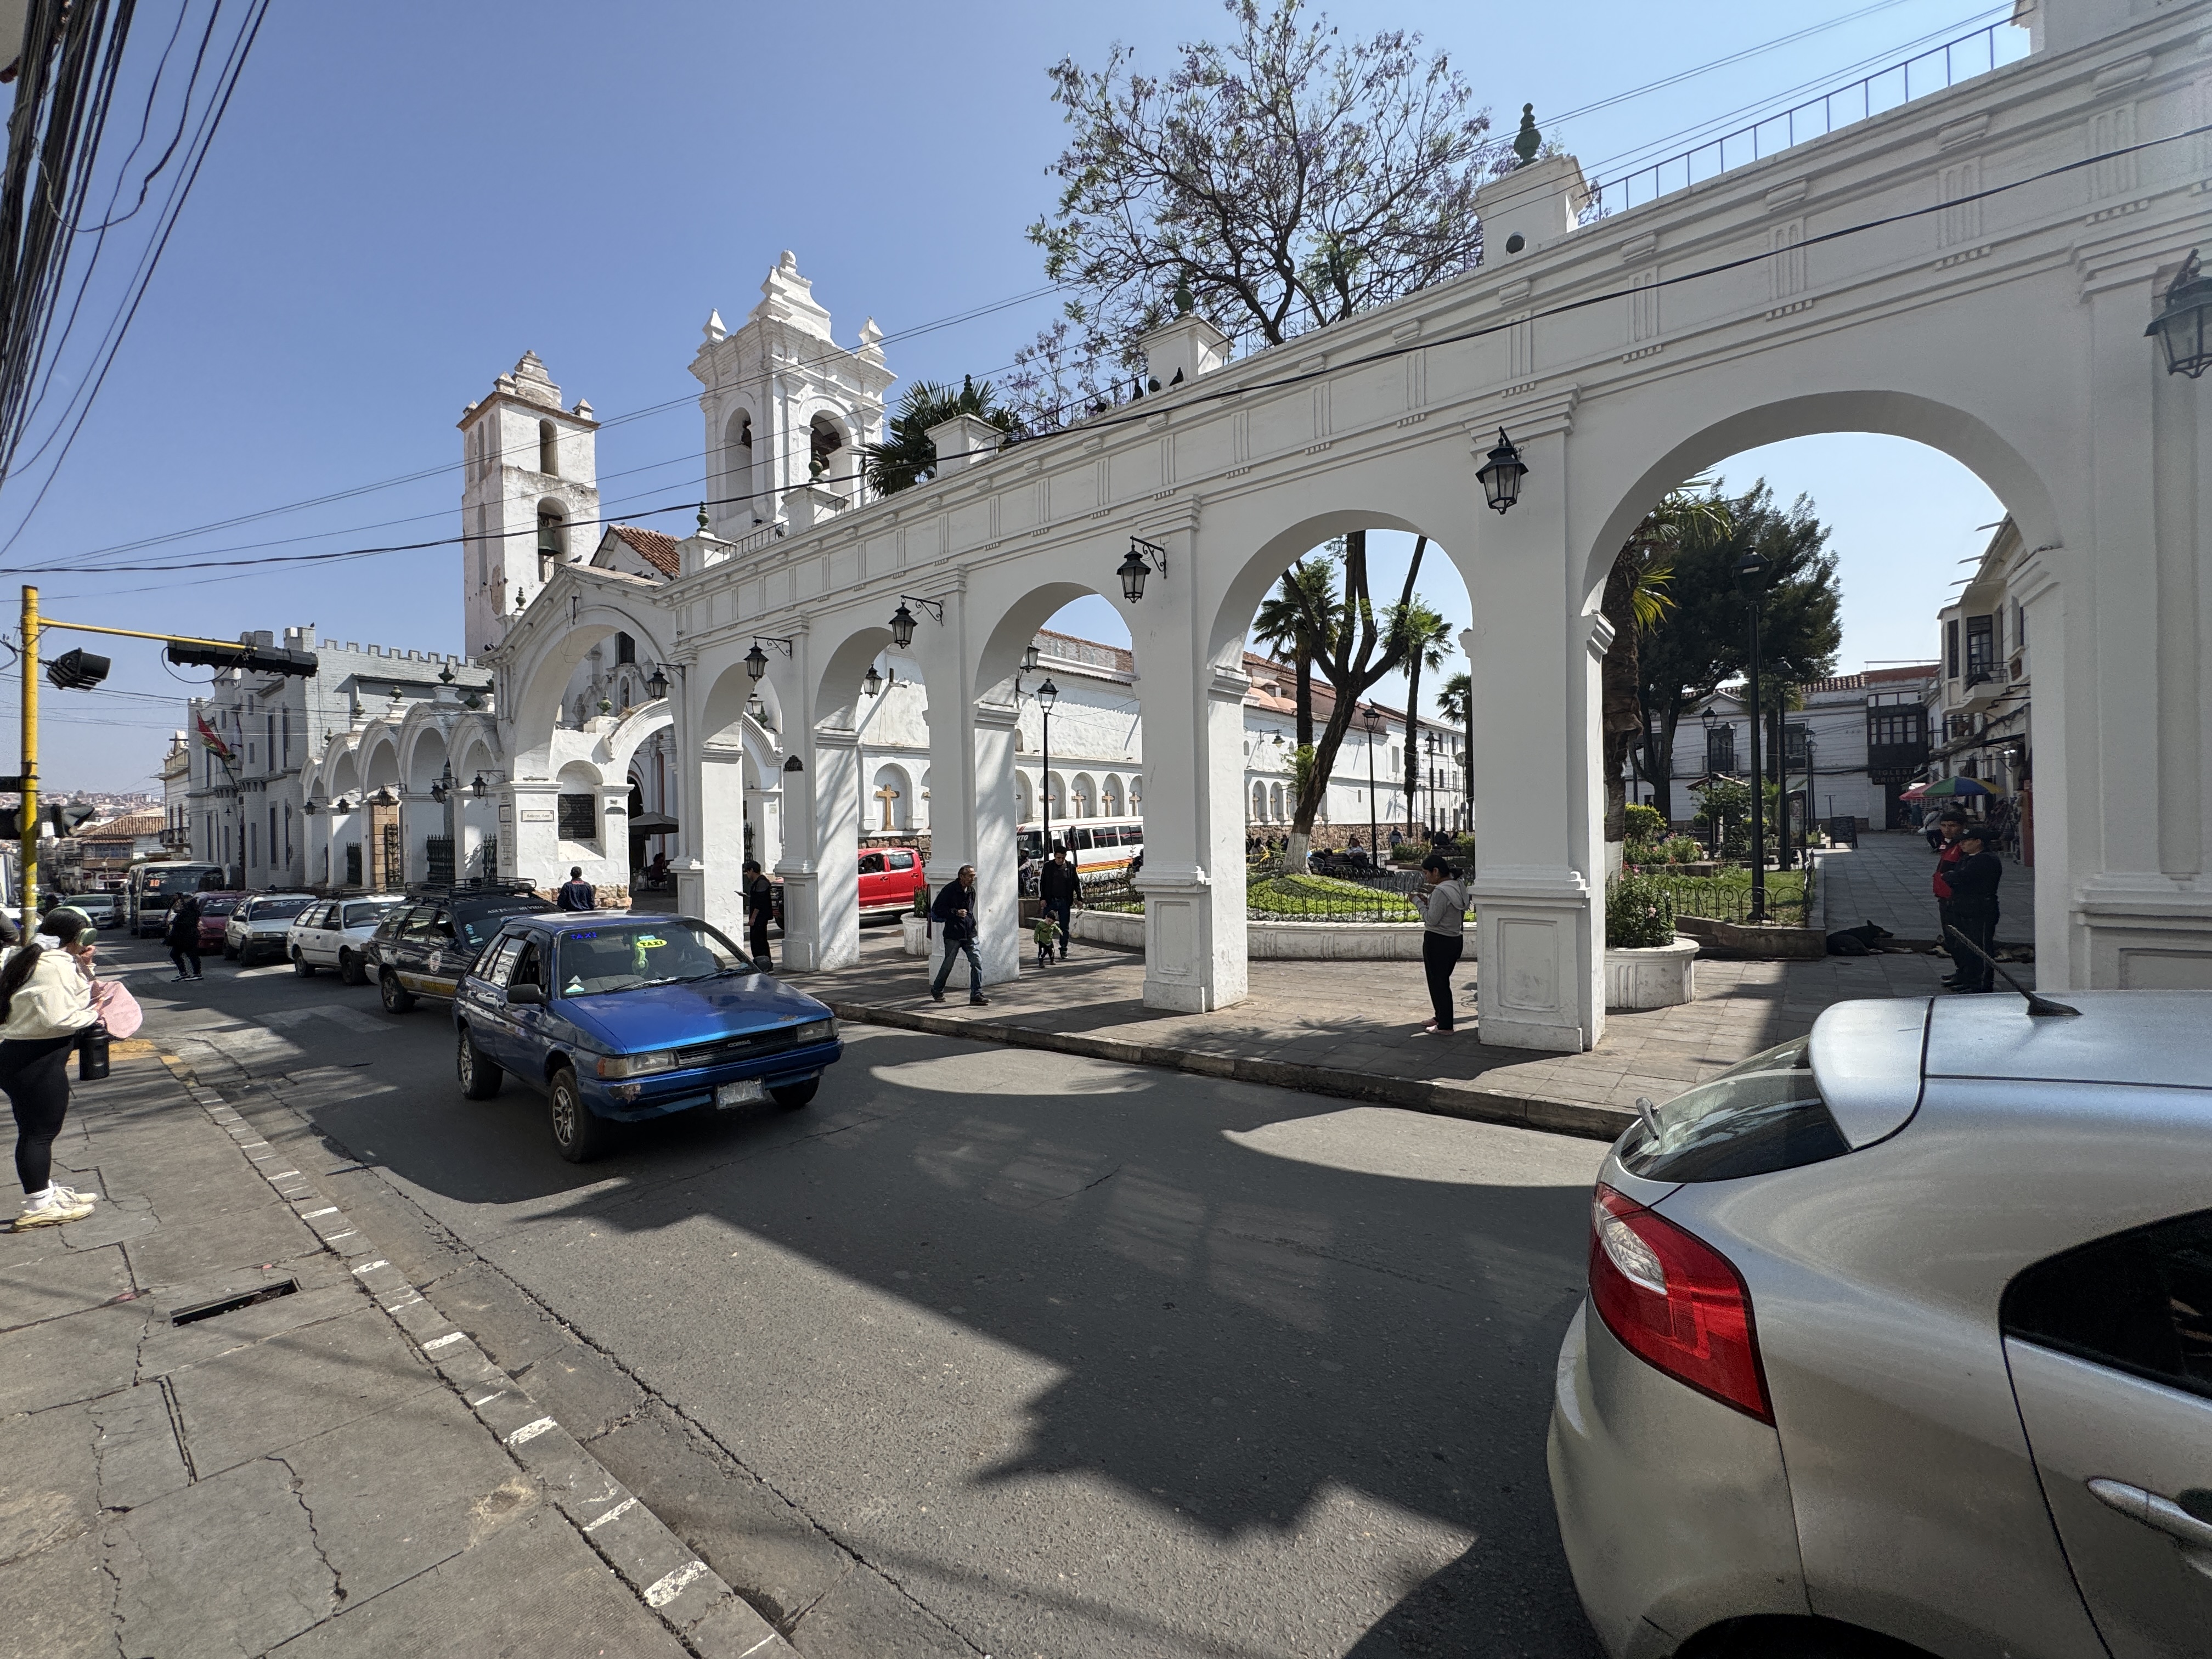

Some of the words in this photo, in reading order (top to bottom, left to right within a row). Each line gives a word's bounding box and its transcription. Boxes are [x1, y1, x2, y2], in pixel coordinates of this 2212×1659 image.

[149, 879, 160, 887] 10
[570, 931, 597, 940] TAXI
[727, 1039, 752, 1047] CORSA
